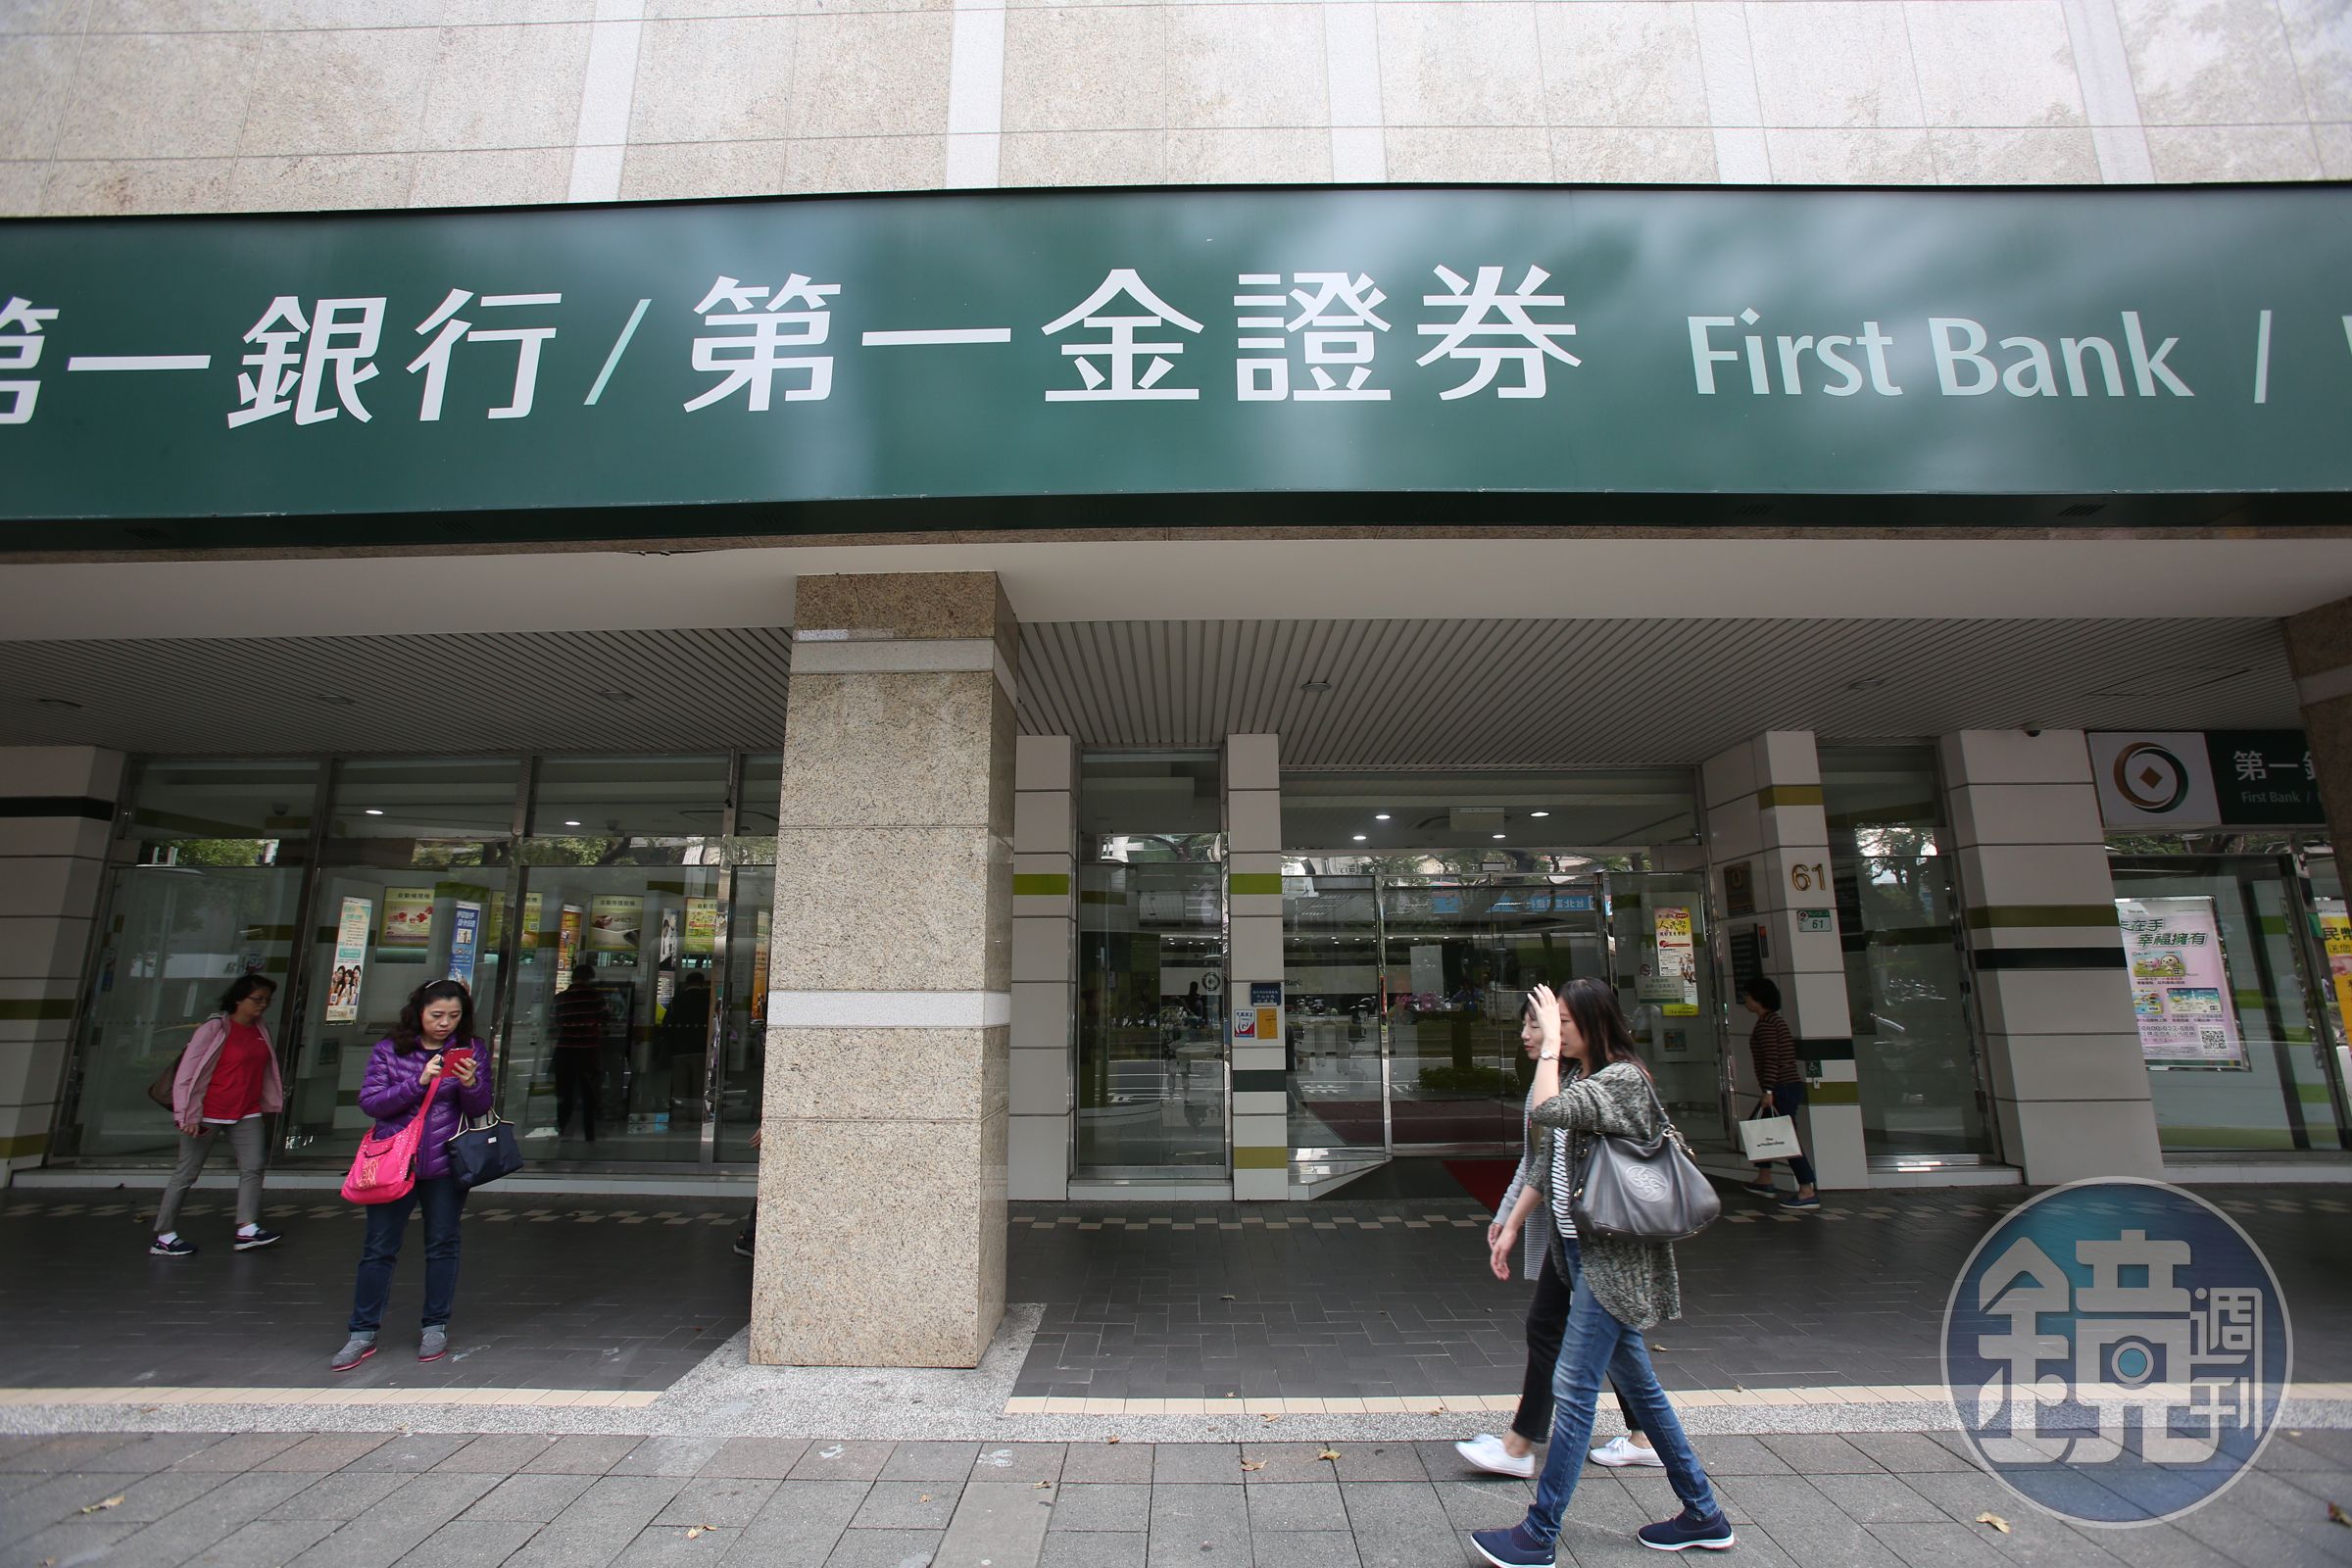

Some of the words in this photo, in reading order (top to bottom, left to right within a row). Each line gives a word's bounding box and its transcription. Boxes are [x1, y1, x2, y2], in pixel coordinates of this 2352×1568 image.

[1687, 307, 1903, 397] First
[1928, 311, 2195, 398] Bank
[2241, 791, 2267, 804] First
[2269, 791, 2301, 803] Bank
[1791, 862, 1827, 892] 61
[1812, 919, 1824, 929] 61
[2137, 932, 2207, 948] 幸福擁有
